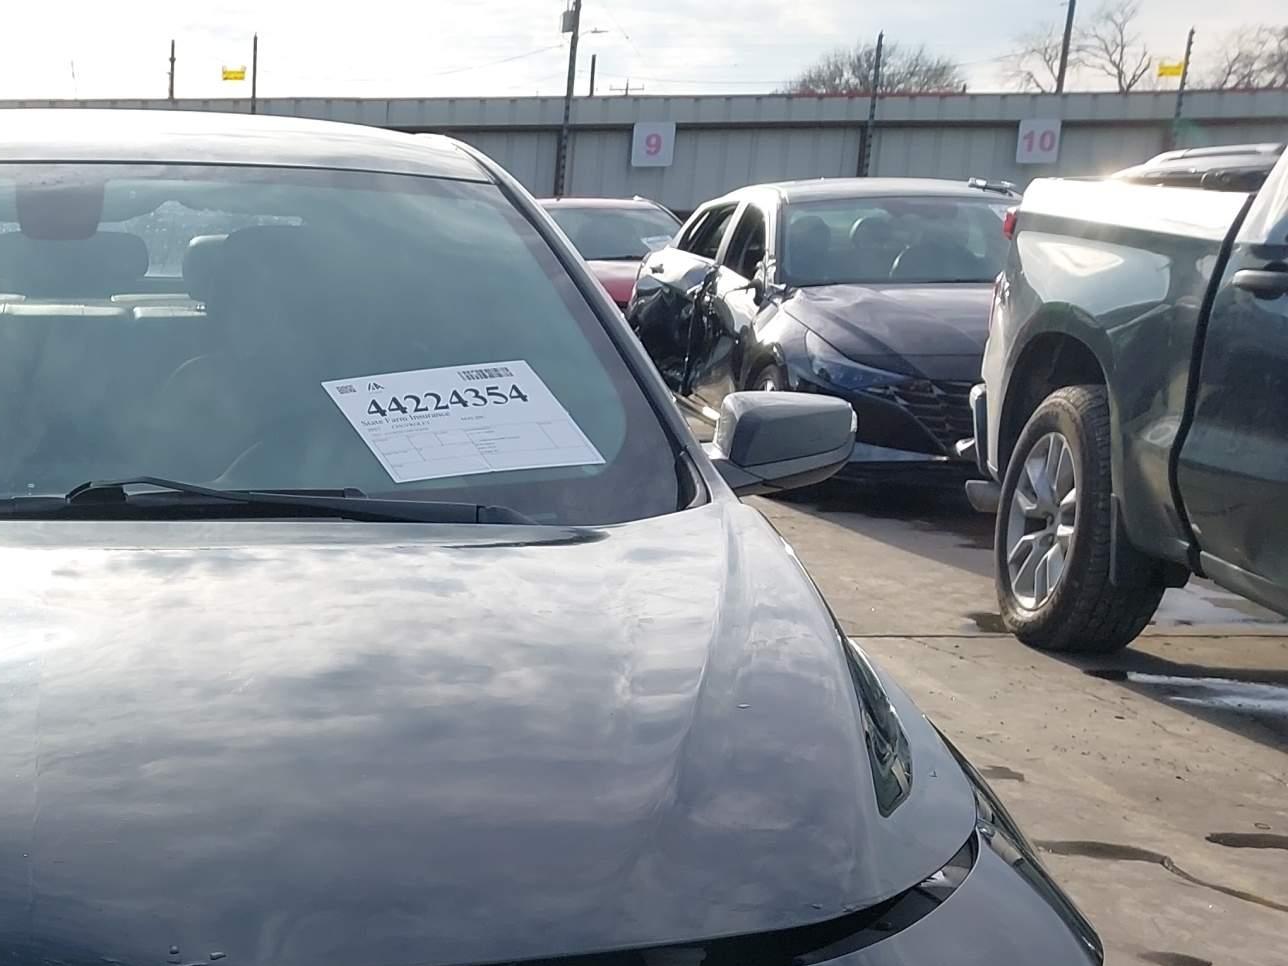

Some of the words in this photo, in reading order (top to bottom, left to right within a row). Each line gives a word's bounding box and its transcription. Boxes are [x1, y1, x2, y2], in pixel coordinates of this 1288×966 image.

[645, 132, 663, 157] 9
[1023, 129, 1056, 153] 10
[367, 384, 529, 417] 44224354
[361, 419, 384, 427] State
[385, 416, 408, 424] Farm
[409, 411, 451, 422] Insurance
